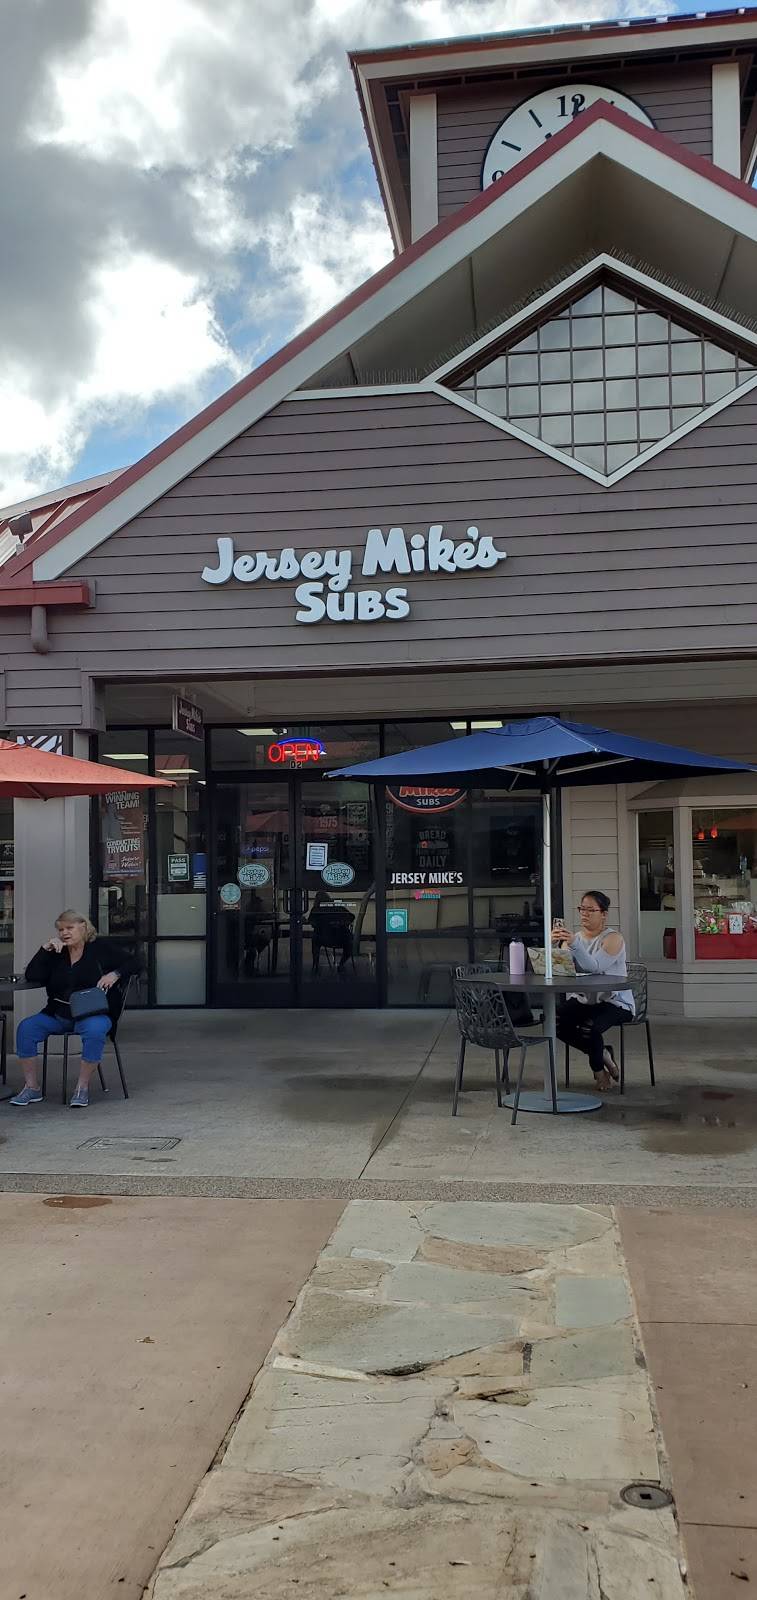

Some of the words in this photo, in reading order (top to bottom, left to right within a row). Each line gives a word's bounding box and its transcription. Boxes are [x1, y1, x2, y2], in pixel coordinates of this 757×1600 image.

[556, 93, 587, 118] 12
[201, 537, 352, 592] Jersey
[361, 525, 507, 576] Mike's
[268, 743, 320, 763] OPEN
[105, 792, 140, 804] WINNING
[416, 798, 440, 806] SUBS
[116, 800, 140, 810] TEAM!
[106, 838, 140, 847] CONDUCTING
[107, 844, 140, 854] TRYOUTS!
[419, 855, 447, 868] DAILY
[390, 873, 426, 884] JERSEY
[428, 872, 463, 884] MIKE'S
